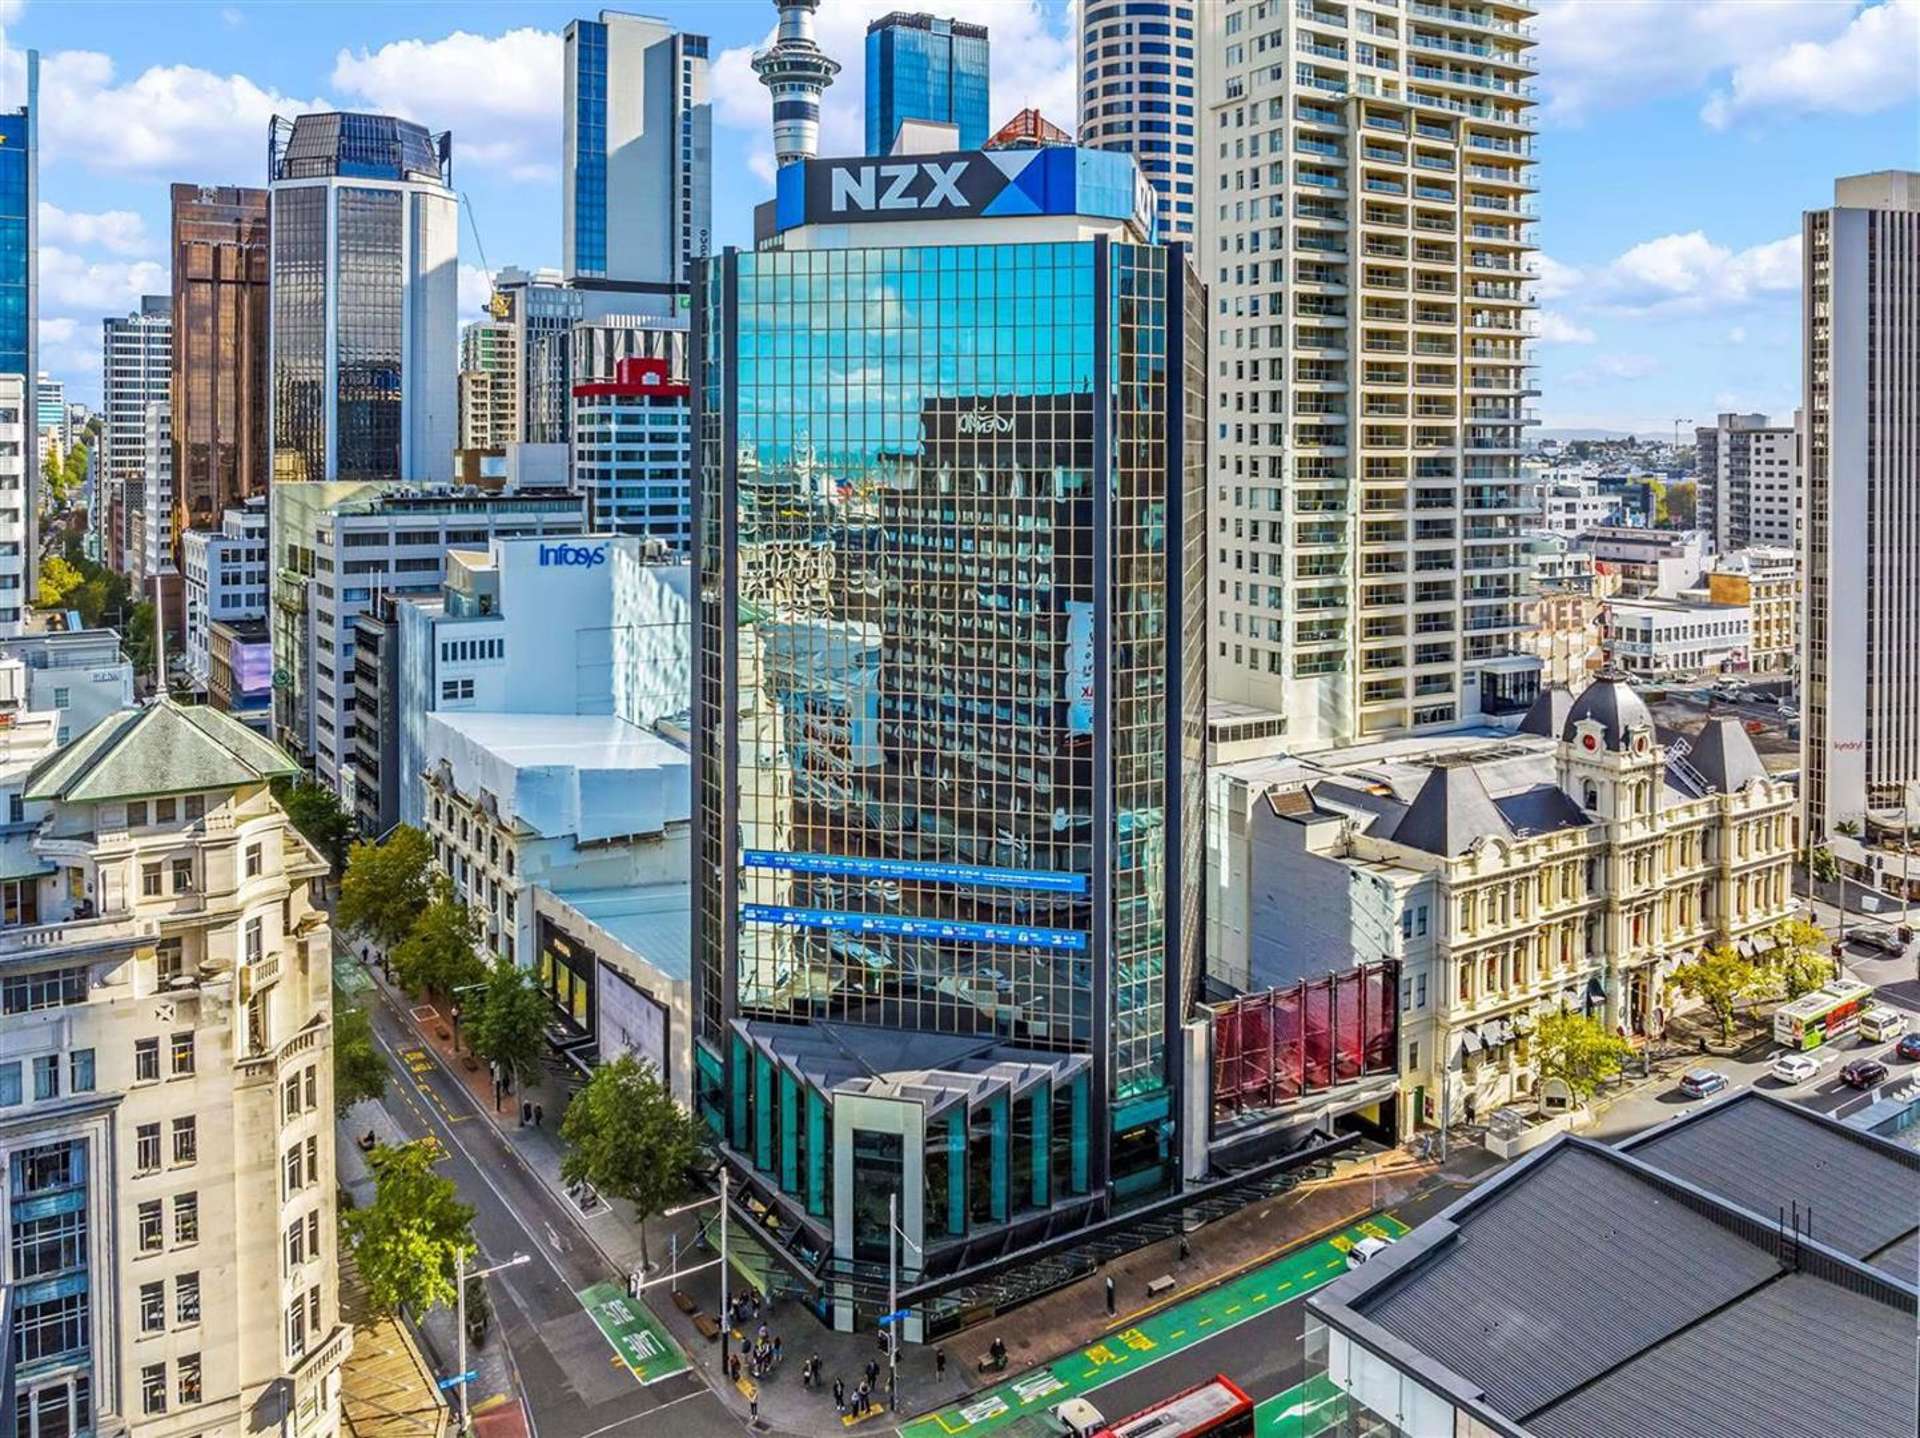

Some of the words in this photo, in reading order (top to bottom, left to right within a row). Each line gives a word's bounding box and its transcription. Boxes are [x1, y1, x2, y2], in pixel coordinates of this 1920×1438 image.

[832, 161, 971, 212] NZX
[539, 543, 605, 568] Infosys
[622, 1330, 665, 1360] LANE
